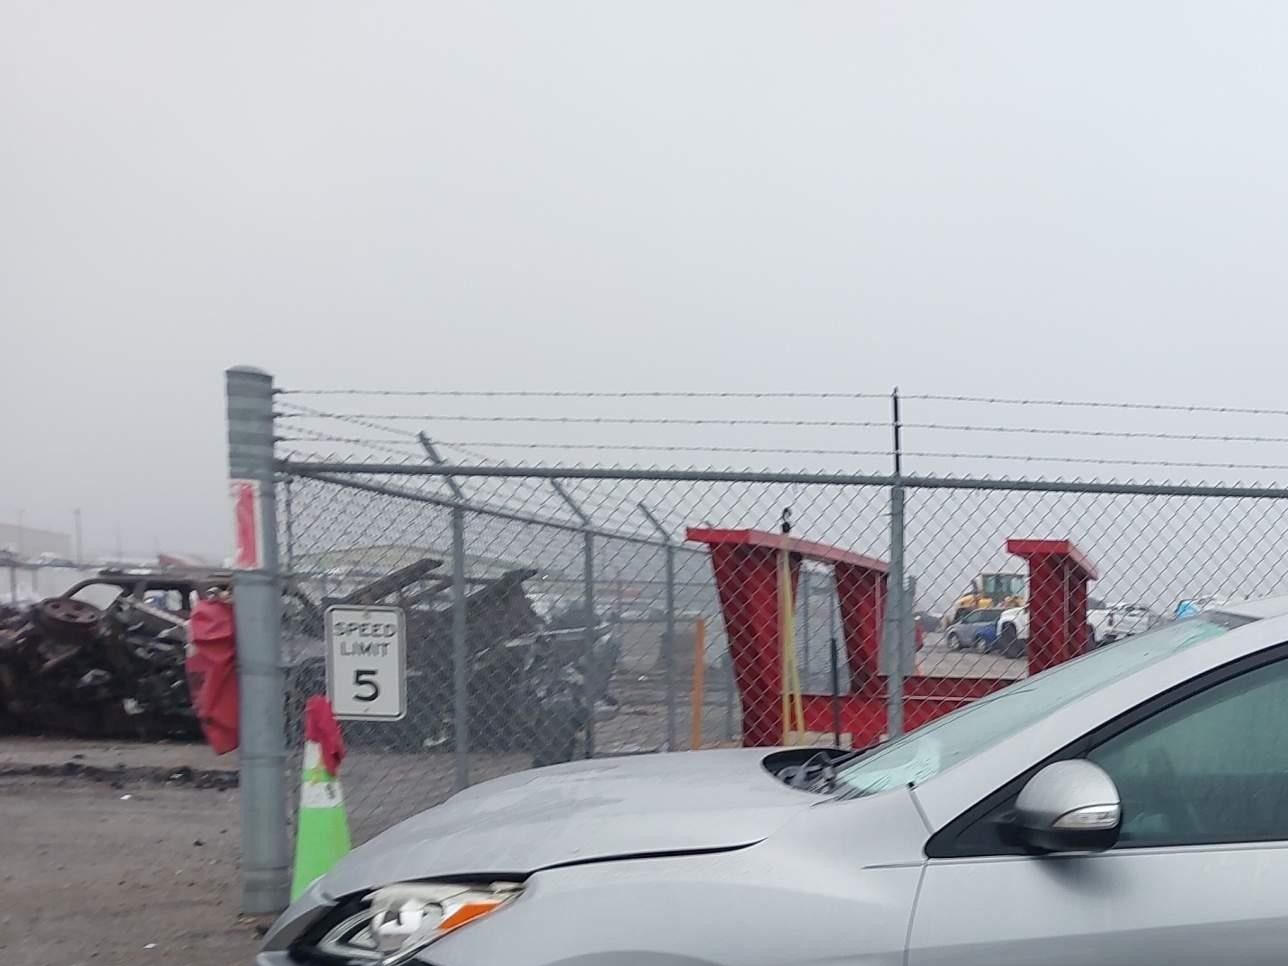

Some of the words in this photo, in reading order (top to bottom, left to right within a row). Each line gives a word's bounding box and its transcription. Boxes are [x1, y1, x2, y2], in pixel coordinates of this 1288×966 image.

[334, 622, 396, 637] SPEED
[340, 641, 390, 657] LIMIT
[352, 669, 380, 702] 5
